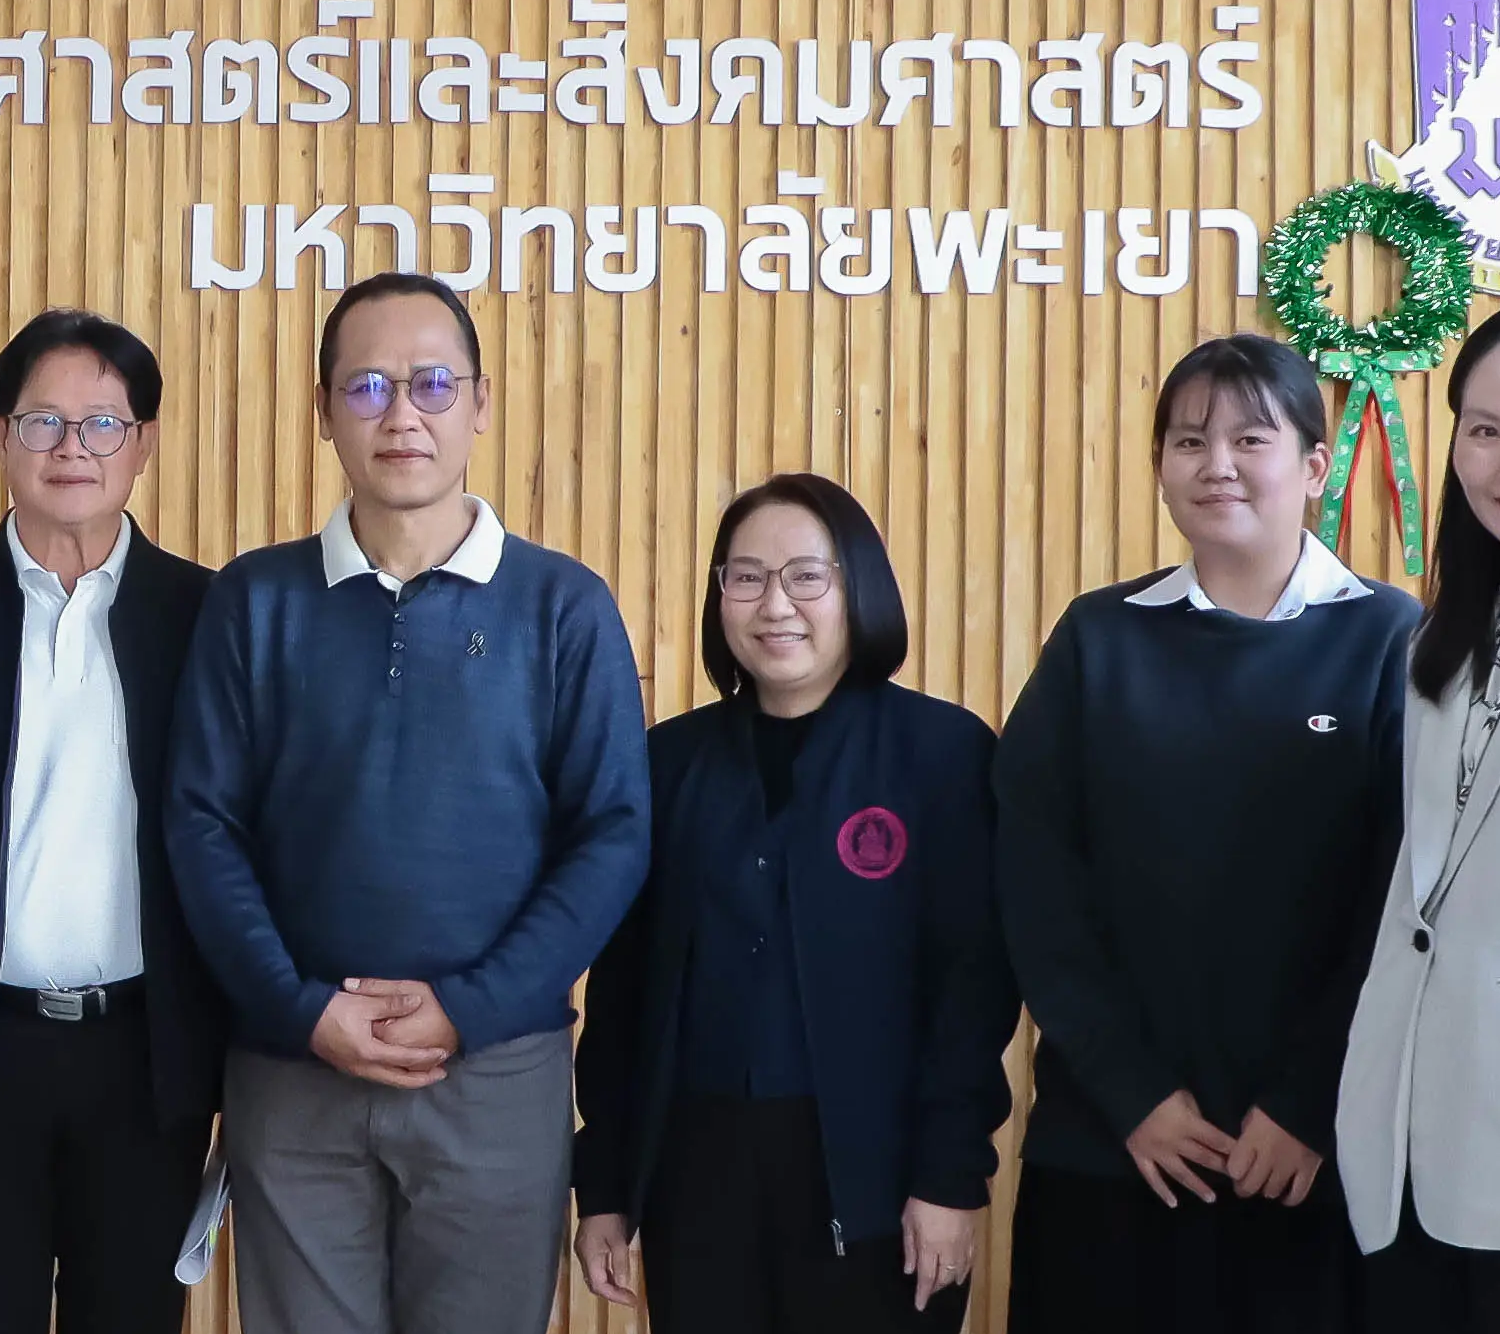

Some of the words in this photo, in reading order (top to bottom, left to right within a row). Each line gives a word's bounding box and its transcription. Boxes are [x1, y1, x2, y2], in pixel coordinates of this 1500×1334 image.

[190, 169, 1261, 297] มหาวิทยาลัยพะเยา
